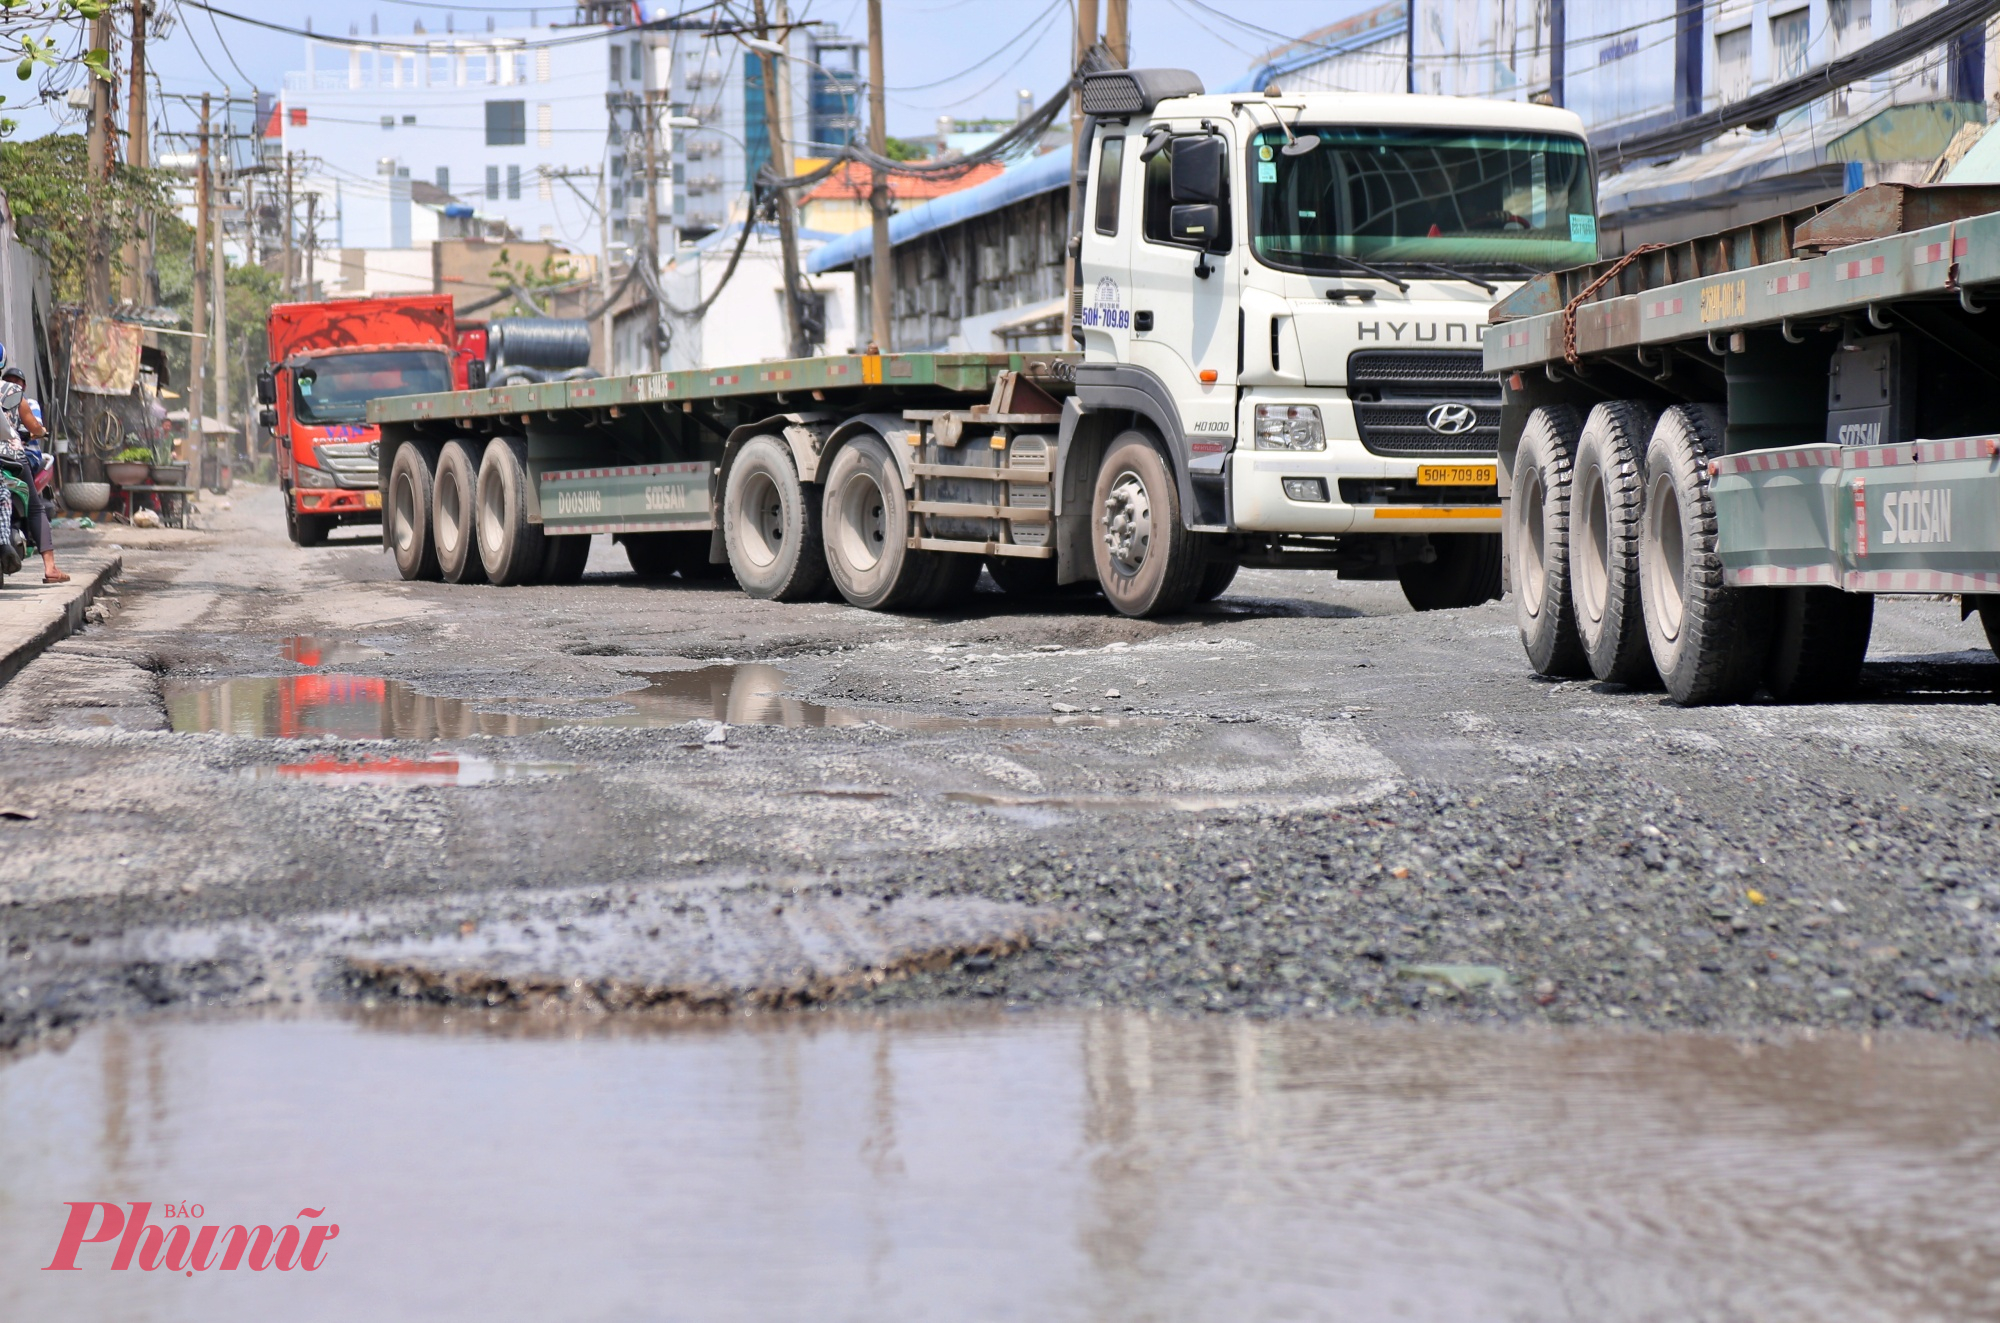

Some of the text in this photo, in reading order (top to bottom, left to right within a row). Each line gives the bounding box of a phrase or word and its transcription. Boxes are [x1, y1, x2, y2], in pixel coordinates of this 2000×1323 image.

[1083, 307, 1130, 329] 50H-709.89
[1194, 421, 1229, 431] HD1000
[1424, 468, 1491, 481] 50H-709.89
[558, 490, 600, 514] DOOSUNG
[1882, 489, 1951, 544] SOOSAN
